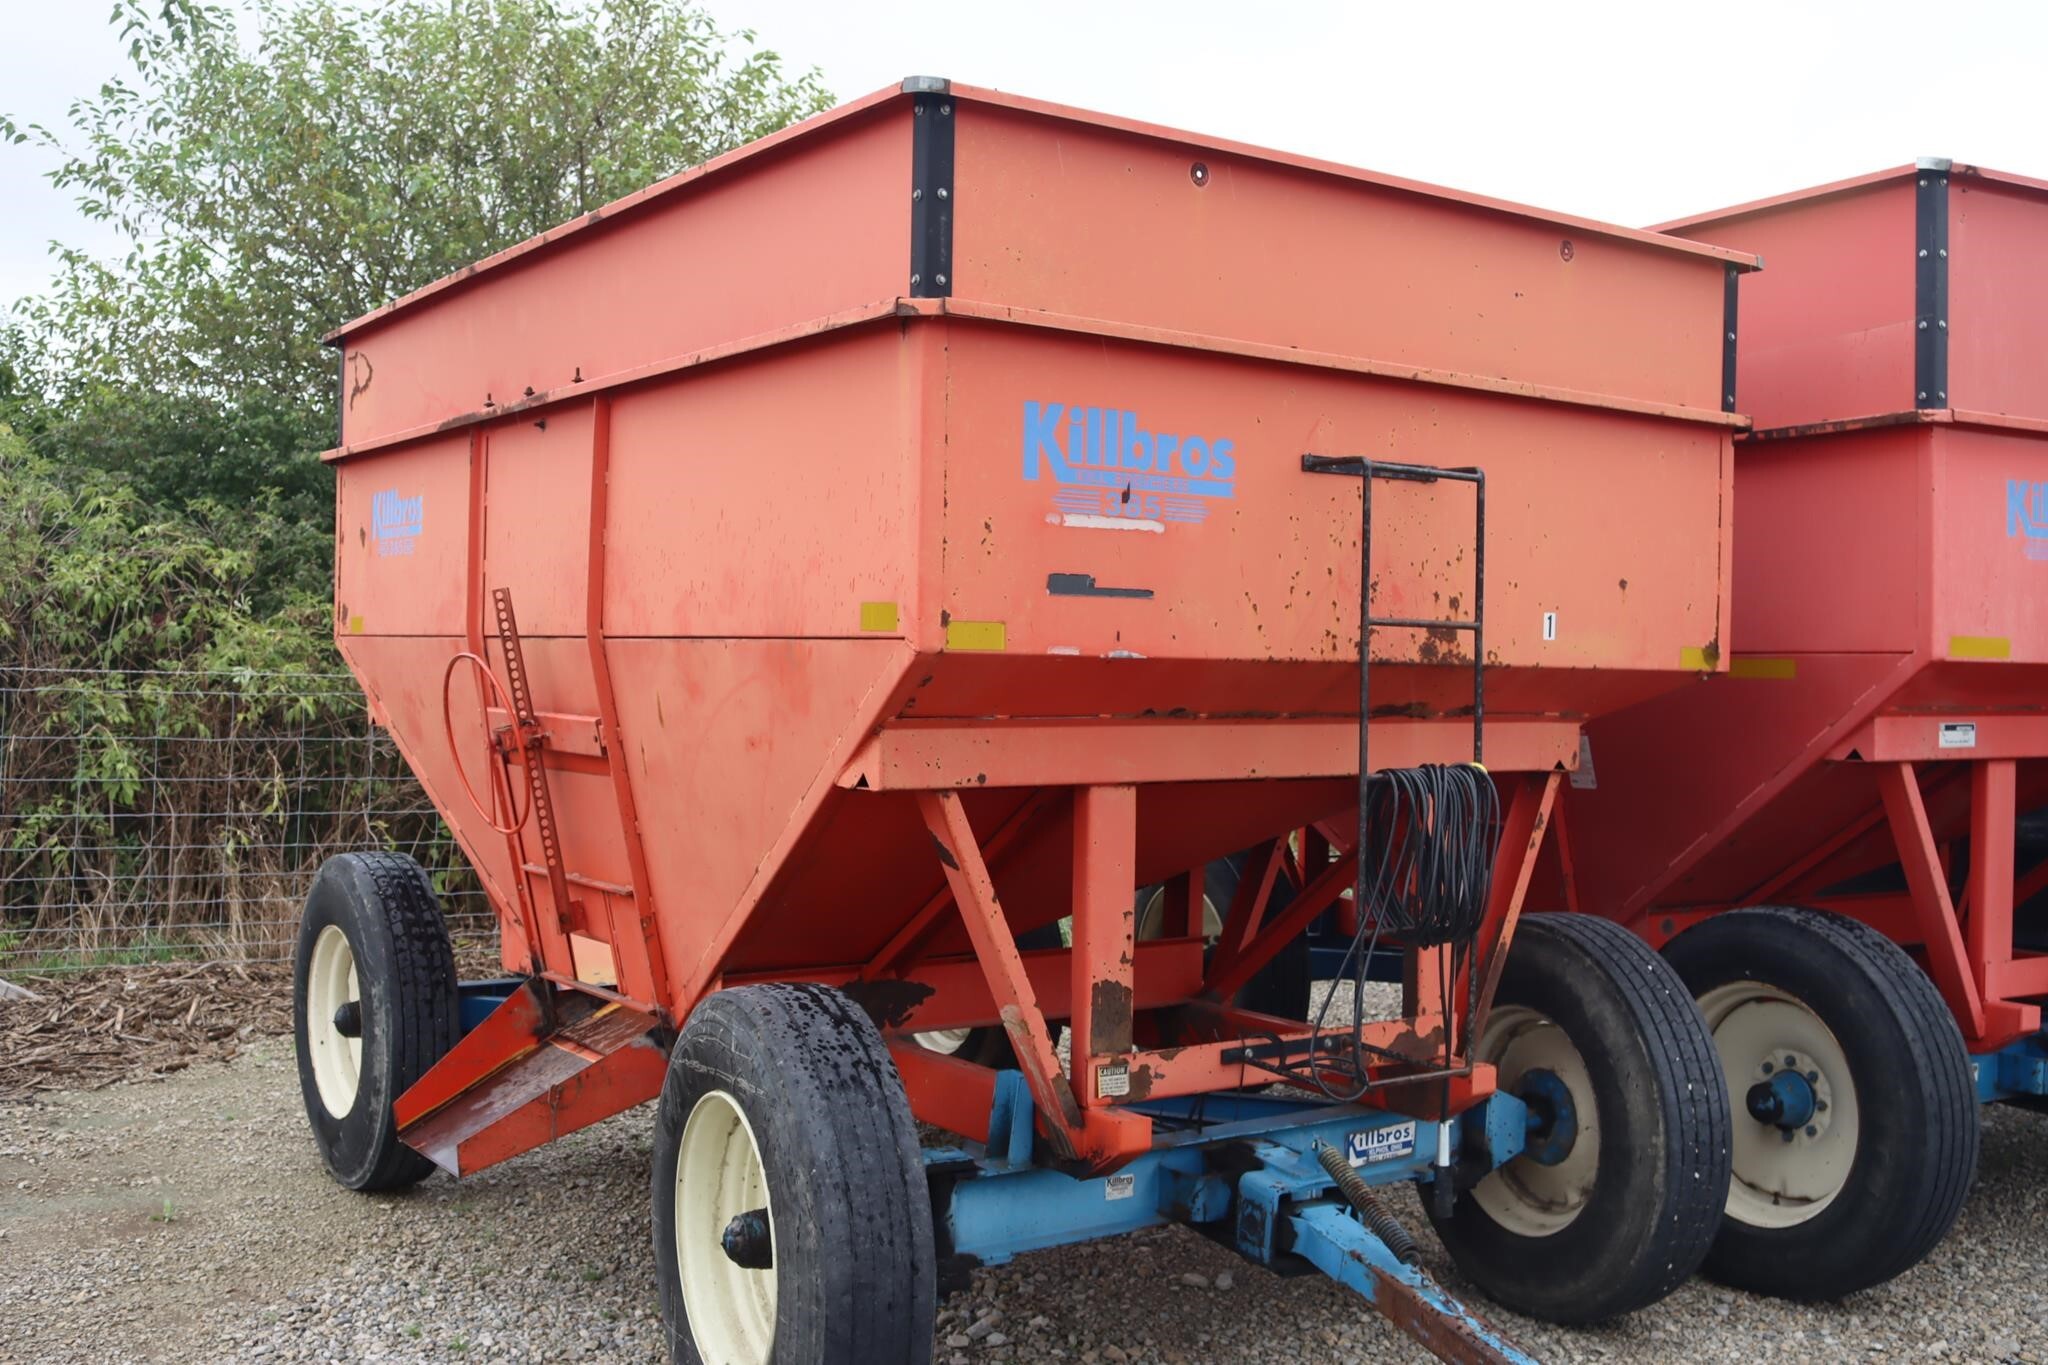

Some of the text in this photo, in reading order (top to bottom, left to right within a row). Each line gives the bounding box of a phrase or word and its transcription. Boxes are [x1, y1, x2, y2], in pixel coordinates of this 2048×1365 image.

[1022, 400, 1236, 481] Killbros
[371, 488, 423, 541] Killbros
[1099, 1066, 1126, 1077] CAUTION
[1345, 1126, 1411, 1160] Killbros
